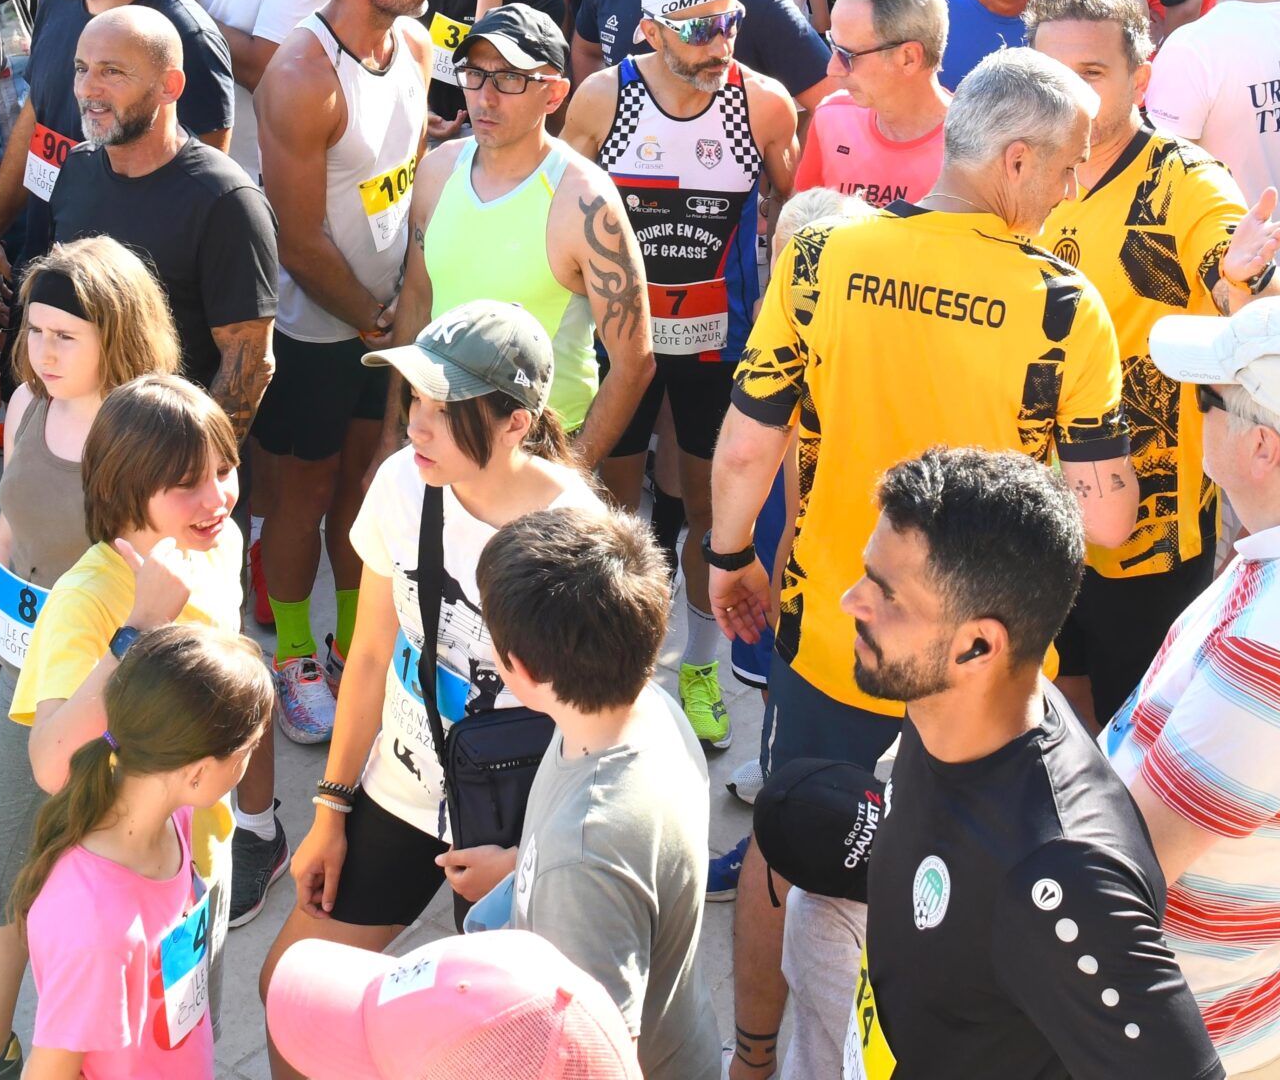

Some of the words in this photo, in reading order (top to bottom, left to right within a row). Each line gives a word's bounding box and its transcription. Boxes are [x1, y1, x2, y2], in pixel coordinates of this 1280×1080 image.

[634, 161, 664, 170] Grasse
[695, 199, 722, 207] STME
[636, 223, 674, 242] OURIR
[676, 223, 693, 238] EN
[693, 227, 723, 251] PAYS
[643, 243, 658, 257] DE
[661, 244, 708, 259] GRASSE
[666, 290, 688, 316] 7
[847, 272, 1007, 329] FRANCESCO
[653, 322, 667, 335] LE
[672, 319, 720, 335] CANNET
[684, 331, 721, 345] D'AZUR
[1179, 369, 1221, 380] Quechua
[18, 587, 38, 623] 8
[486, 760, 520, 770] ugatti
[844, 802, 866, 846] GROTTE
[844, 802, 881, 869] CHAUVET
